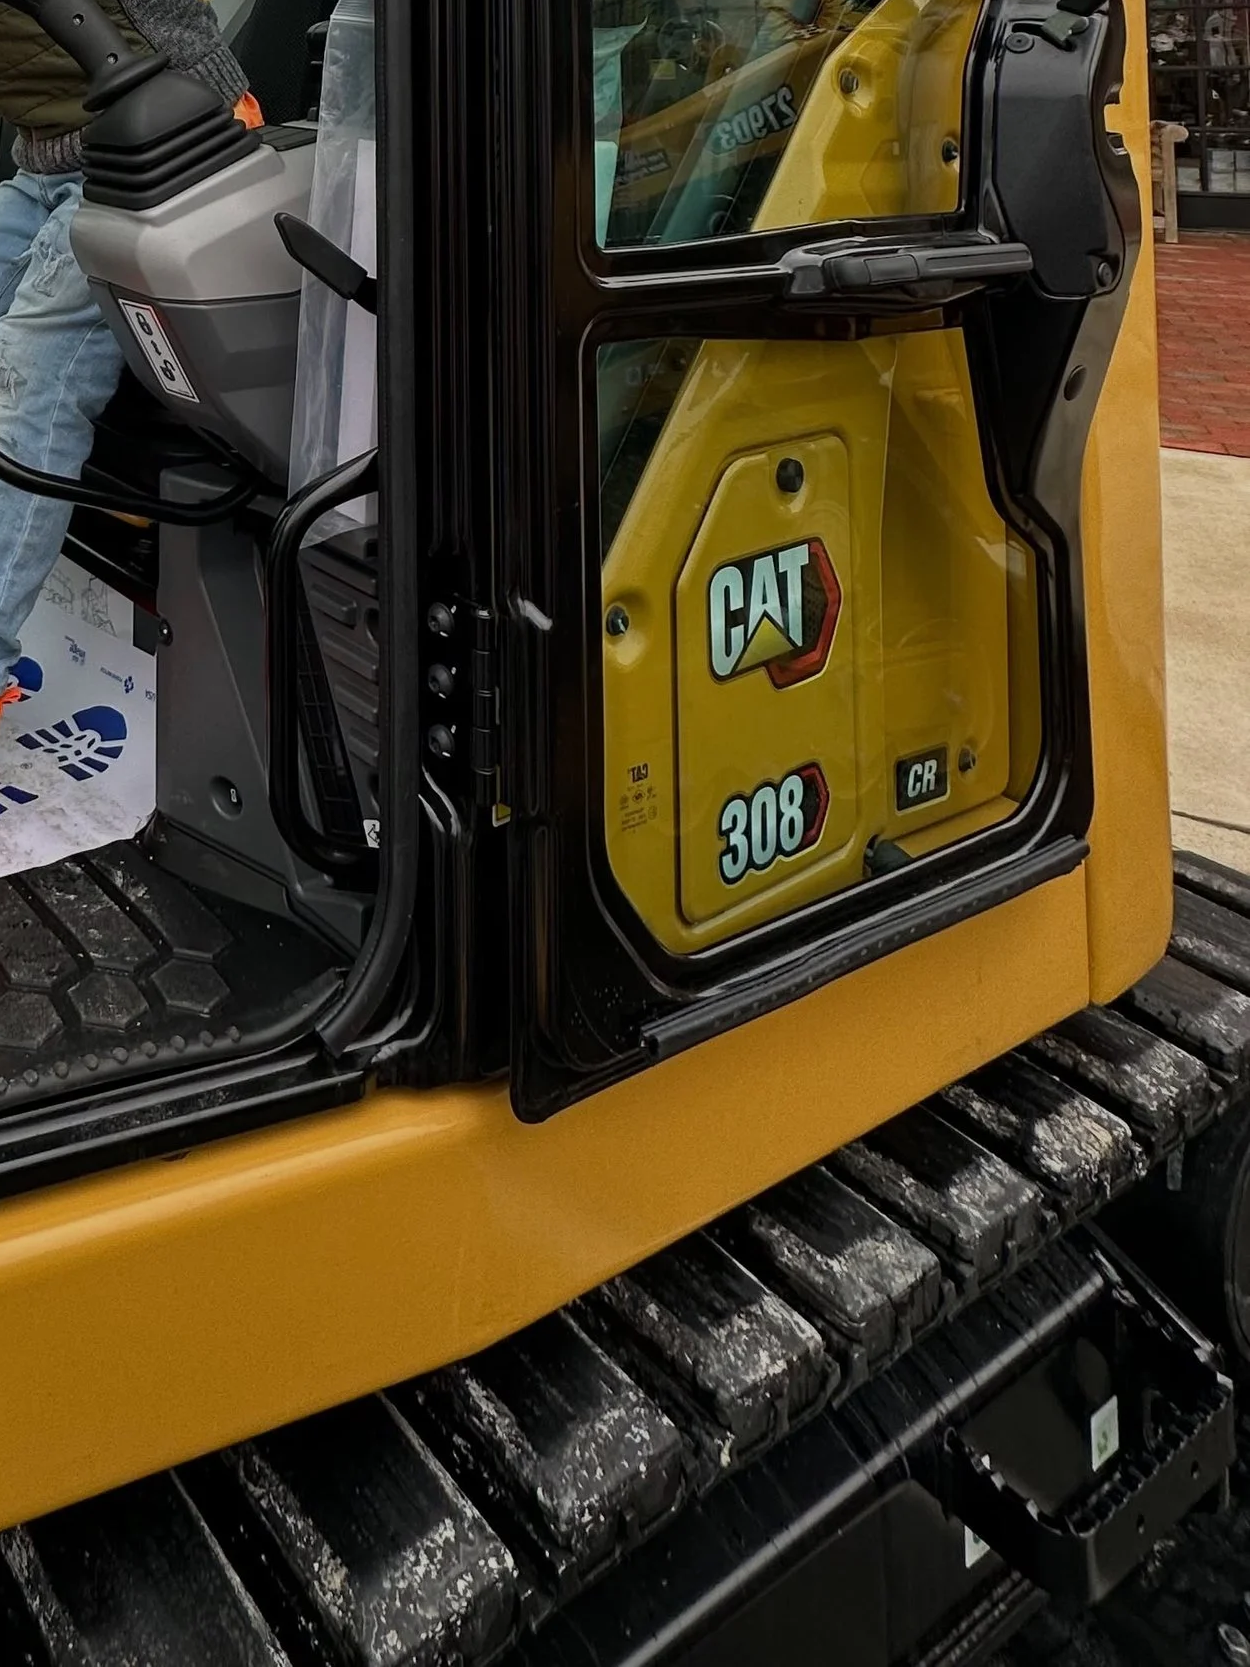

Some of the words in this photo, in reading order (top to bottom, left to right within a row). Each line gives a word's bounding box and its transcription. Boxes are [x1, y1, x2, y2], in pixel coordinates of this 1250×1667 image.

[708, 541, 812, 680] CAT
[721, 774, 805, 880] 308
[907, 758, 938, 796] CR
